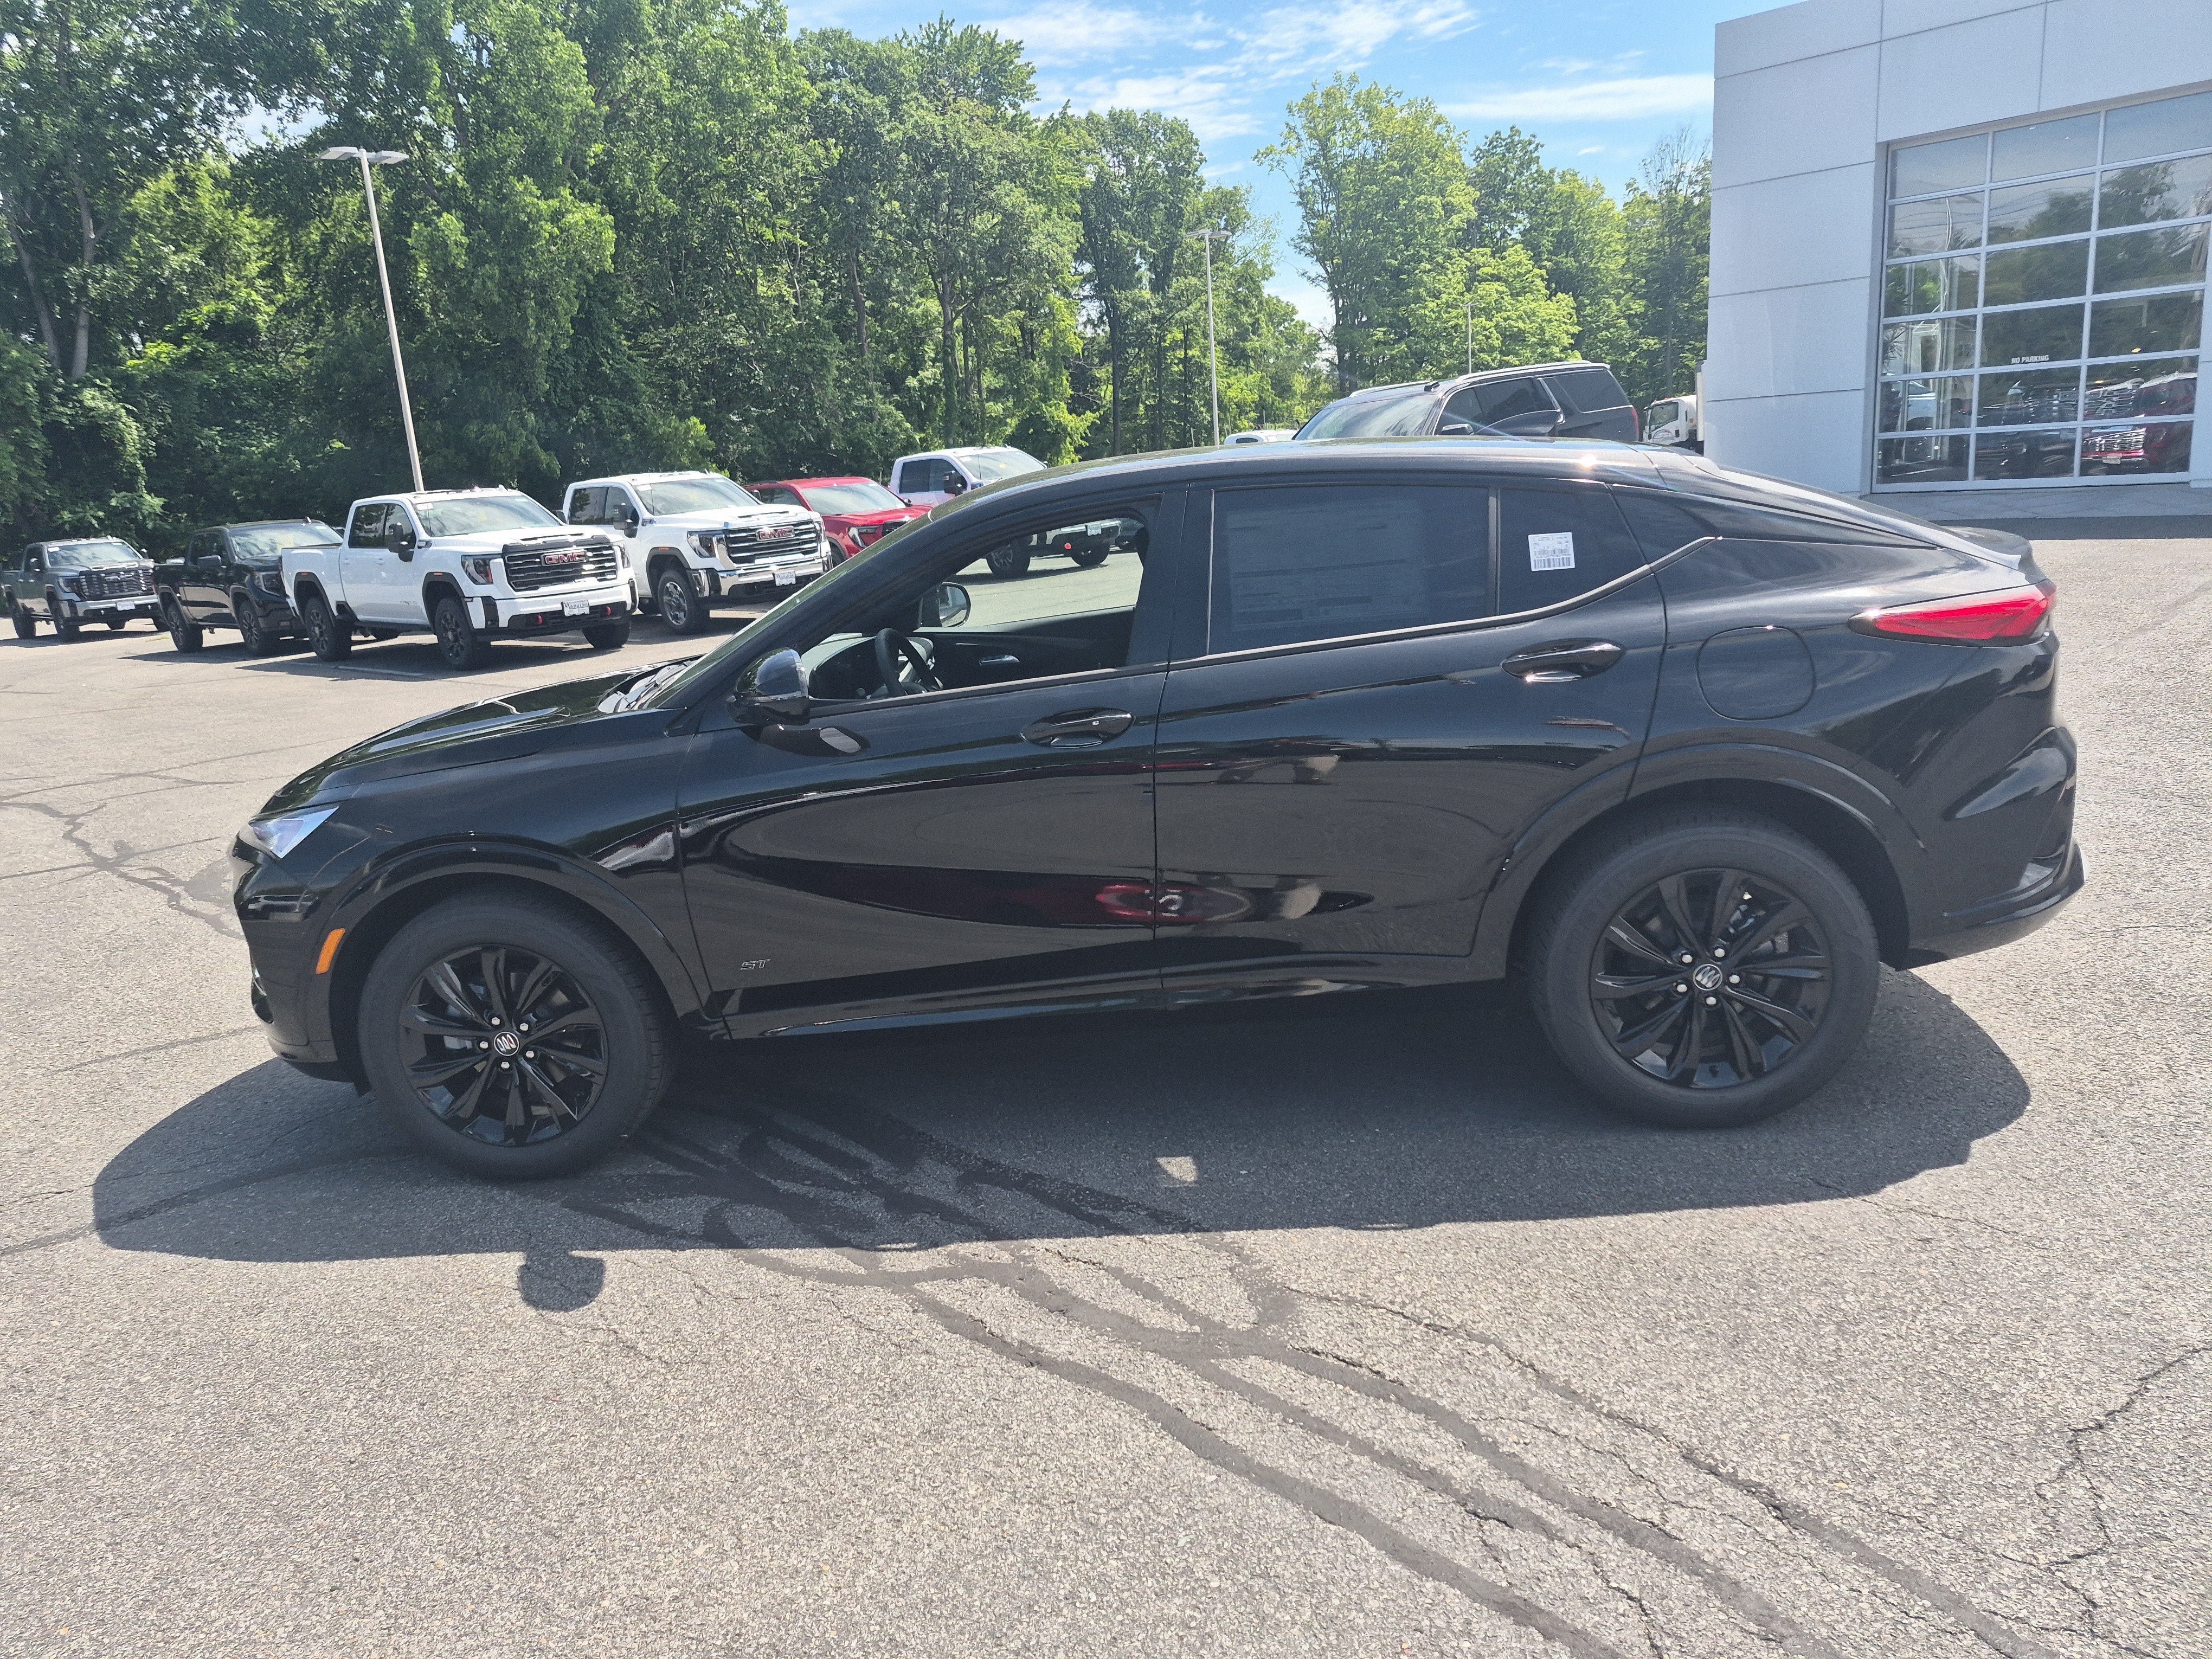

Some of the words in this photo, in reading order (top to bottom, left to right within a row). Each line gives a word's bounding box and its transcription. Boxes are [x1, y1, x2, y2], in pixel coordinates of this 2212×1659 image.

[2021, 355, 2049, 363] PARKING
[760, 528, 793, 539] GMC
[545, 552, 586, 564] GMC
[740, 959, 771, 970] ST
